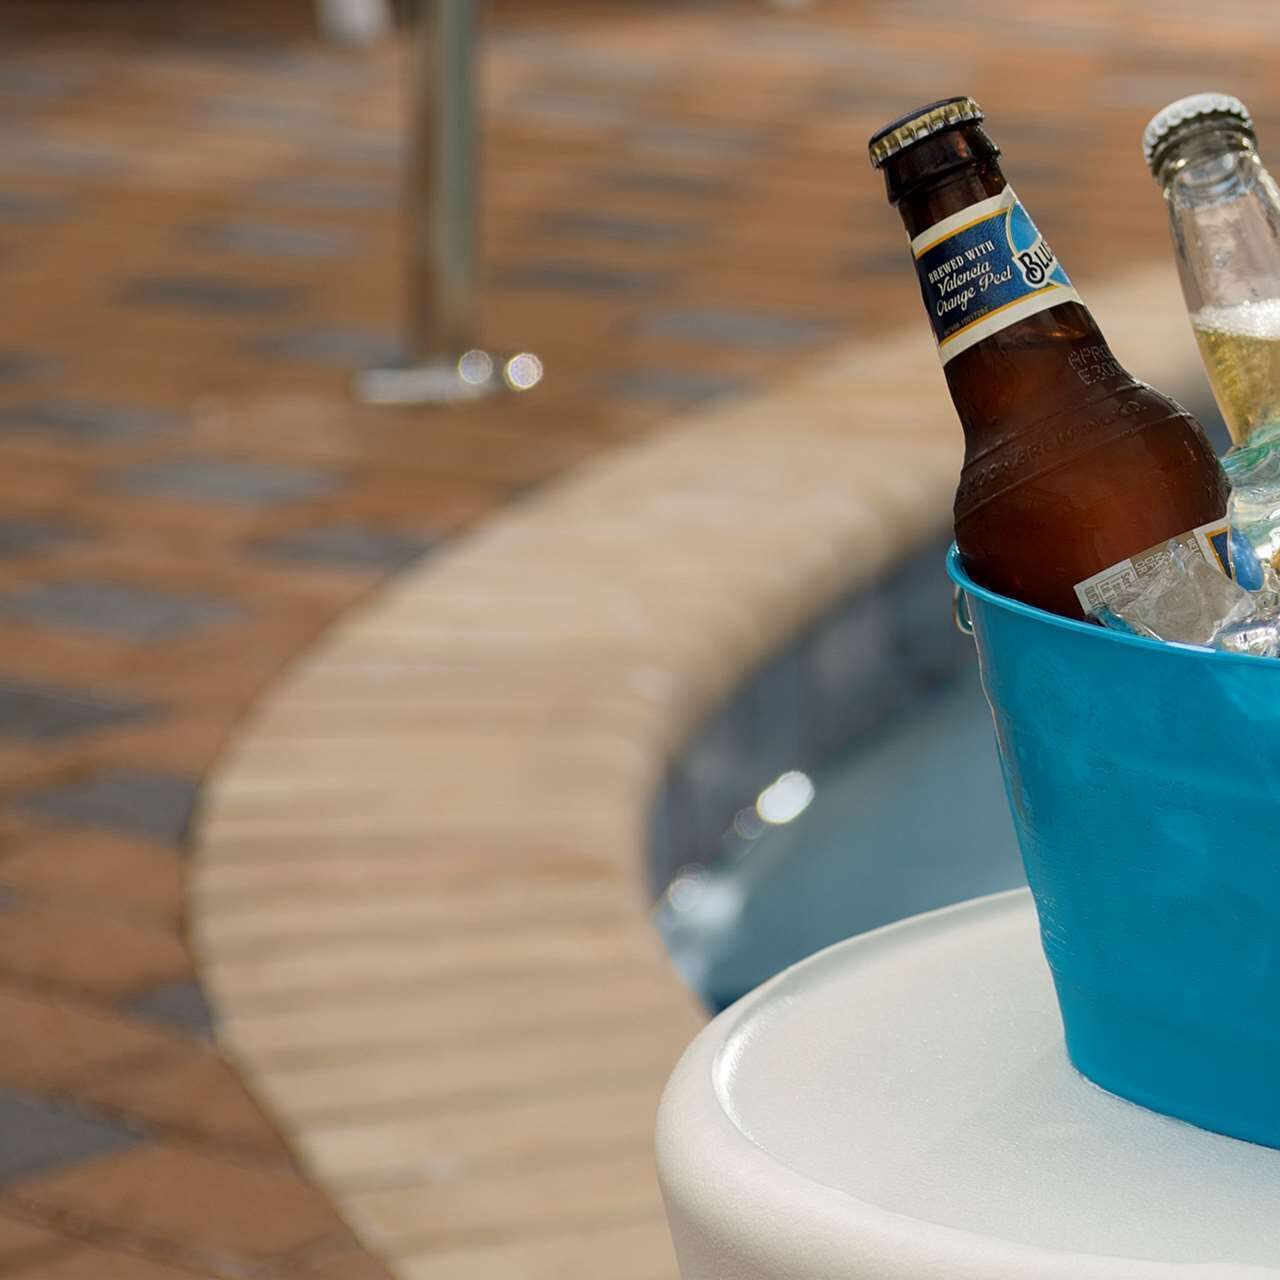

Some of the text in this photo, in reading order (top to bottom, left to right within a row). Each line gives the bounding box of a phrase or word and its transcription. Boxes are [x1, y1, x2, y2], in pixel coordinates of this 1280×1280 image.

[928, 239, 995, 284] BREWED WITH
[937, 261, 992, 297] Valencia
[936, 264, 1014, 317] Orange Peel
